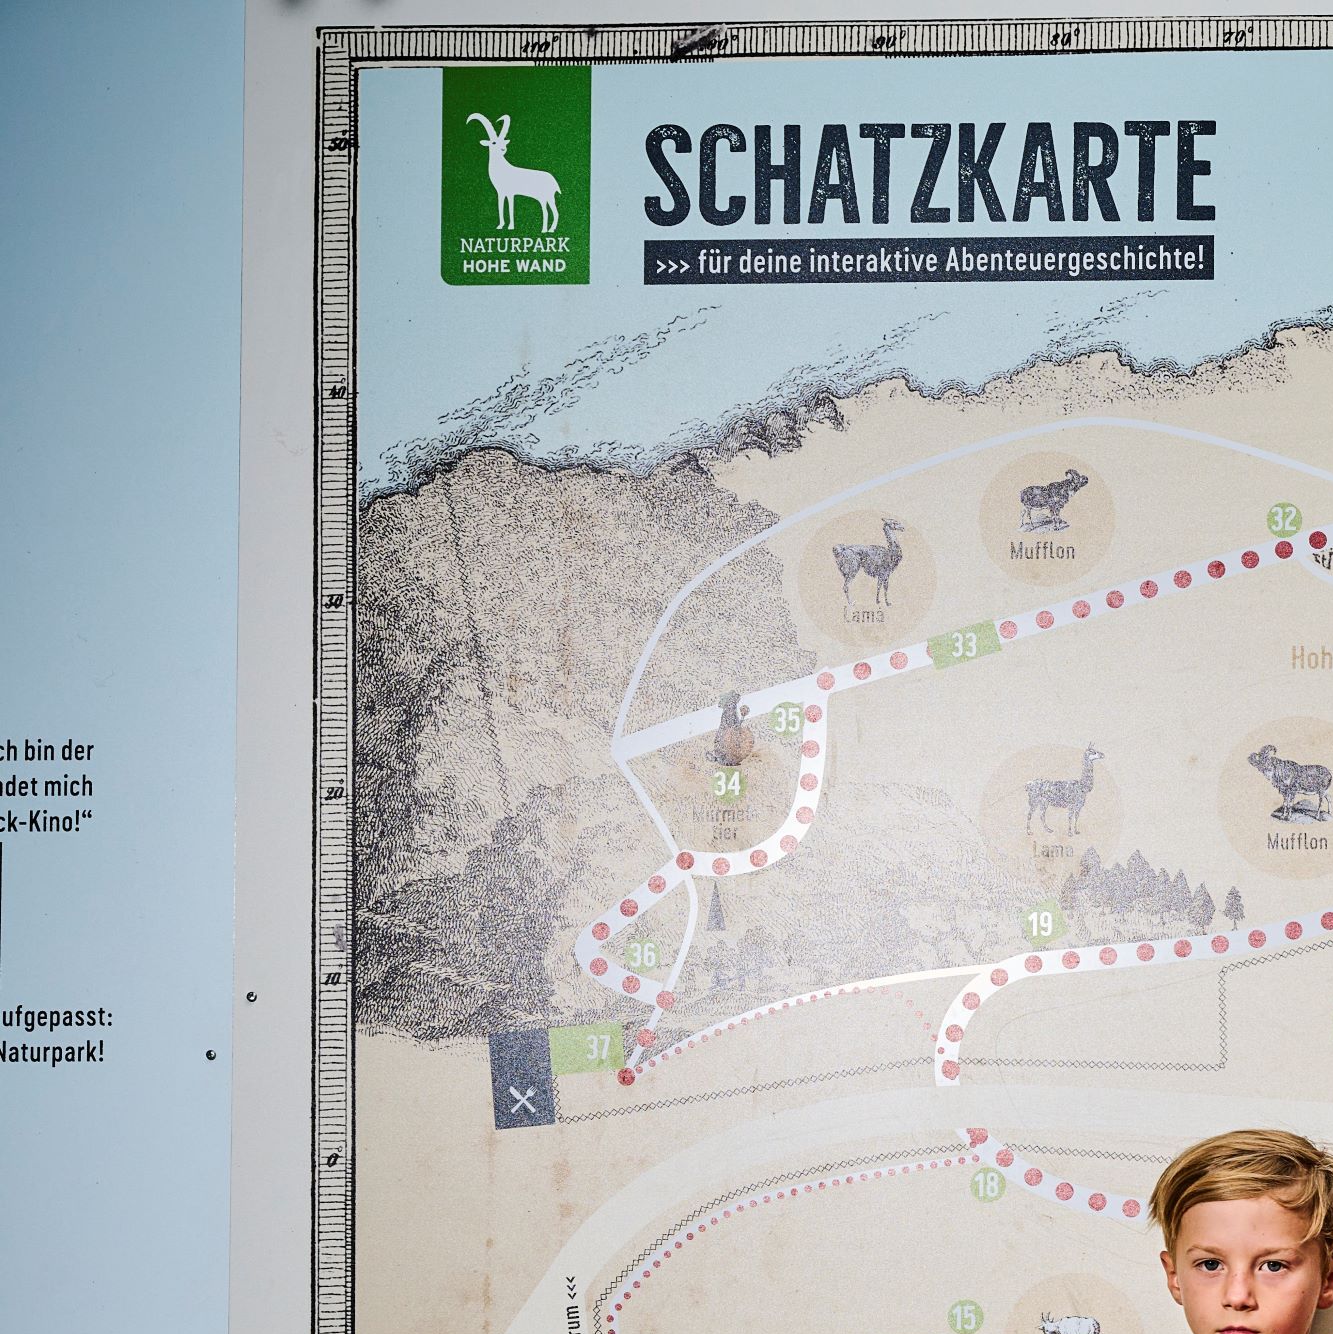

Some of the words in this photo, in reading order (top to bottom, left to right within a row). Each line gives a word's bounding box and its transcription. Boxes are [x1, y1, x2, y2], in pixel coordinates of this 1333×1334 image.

[644, 120, 1217, 227] SCHATZKARTE
[460, 236, 571, 255] NATURPARK
[463, 258, 512, 274] HOHE
[515, 258, 567, 274] WAND
[698, 249, 735, 275] für
[740, 249, 803, 274] deine
[810, 246, 937, 274] interaktive
[946, 245, 1205, 278] Abenteuergeschichte!
[1271, 507, 1297, 531] 32
[1010, 541, 1075, 560] Mufflon
[952, 632, 977, 657] 33
[775, 708, 800, 732] 35
[25, 739, 55, 761] bin
[61, 739, 94, 761] der
[45, 774, 93, 797] mich
[714, 771, 741, 796] 34
[1267, 832, 1328, 851] Mufflon
[1028, 912, 1054, 937] 19
[630, 943, 656, 967] 36
[586, 1035, 611, 1060] 37
[974, 1172, 998, 1199] 18
[953, 1306, 976, 1331] 15
